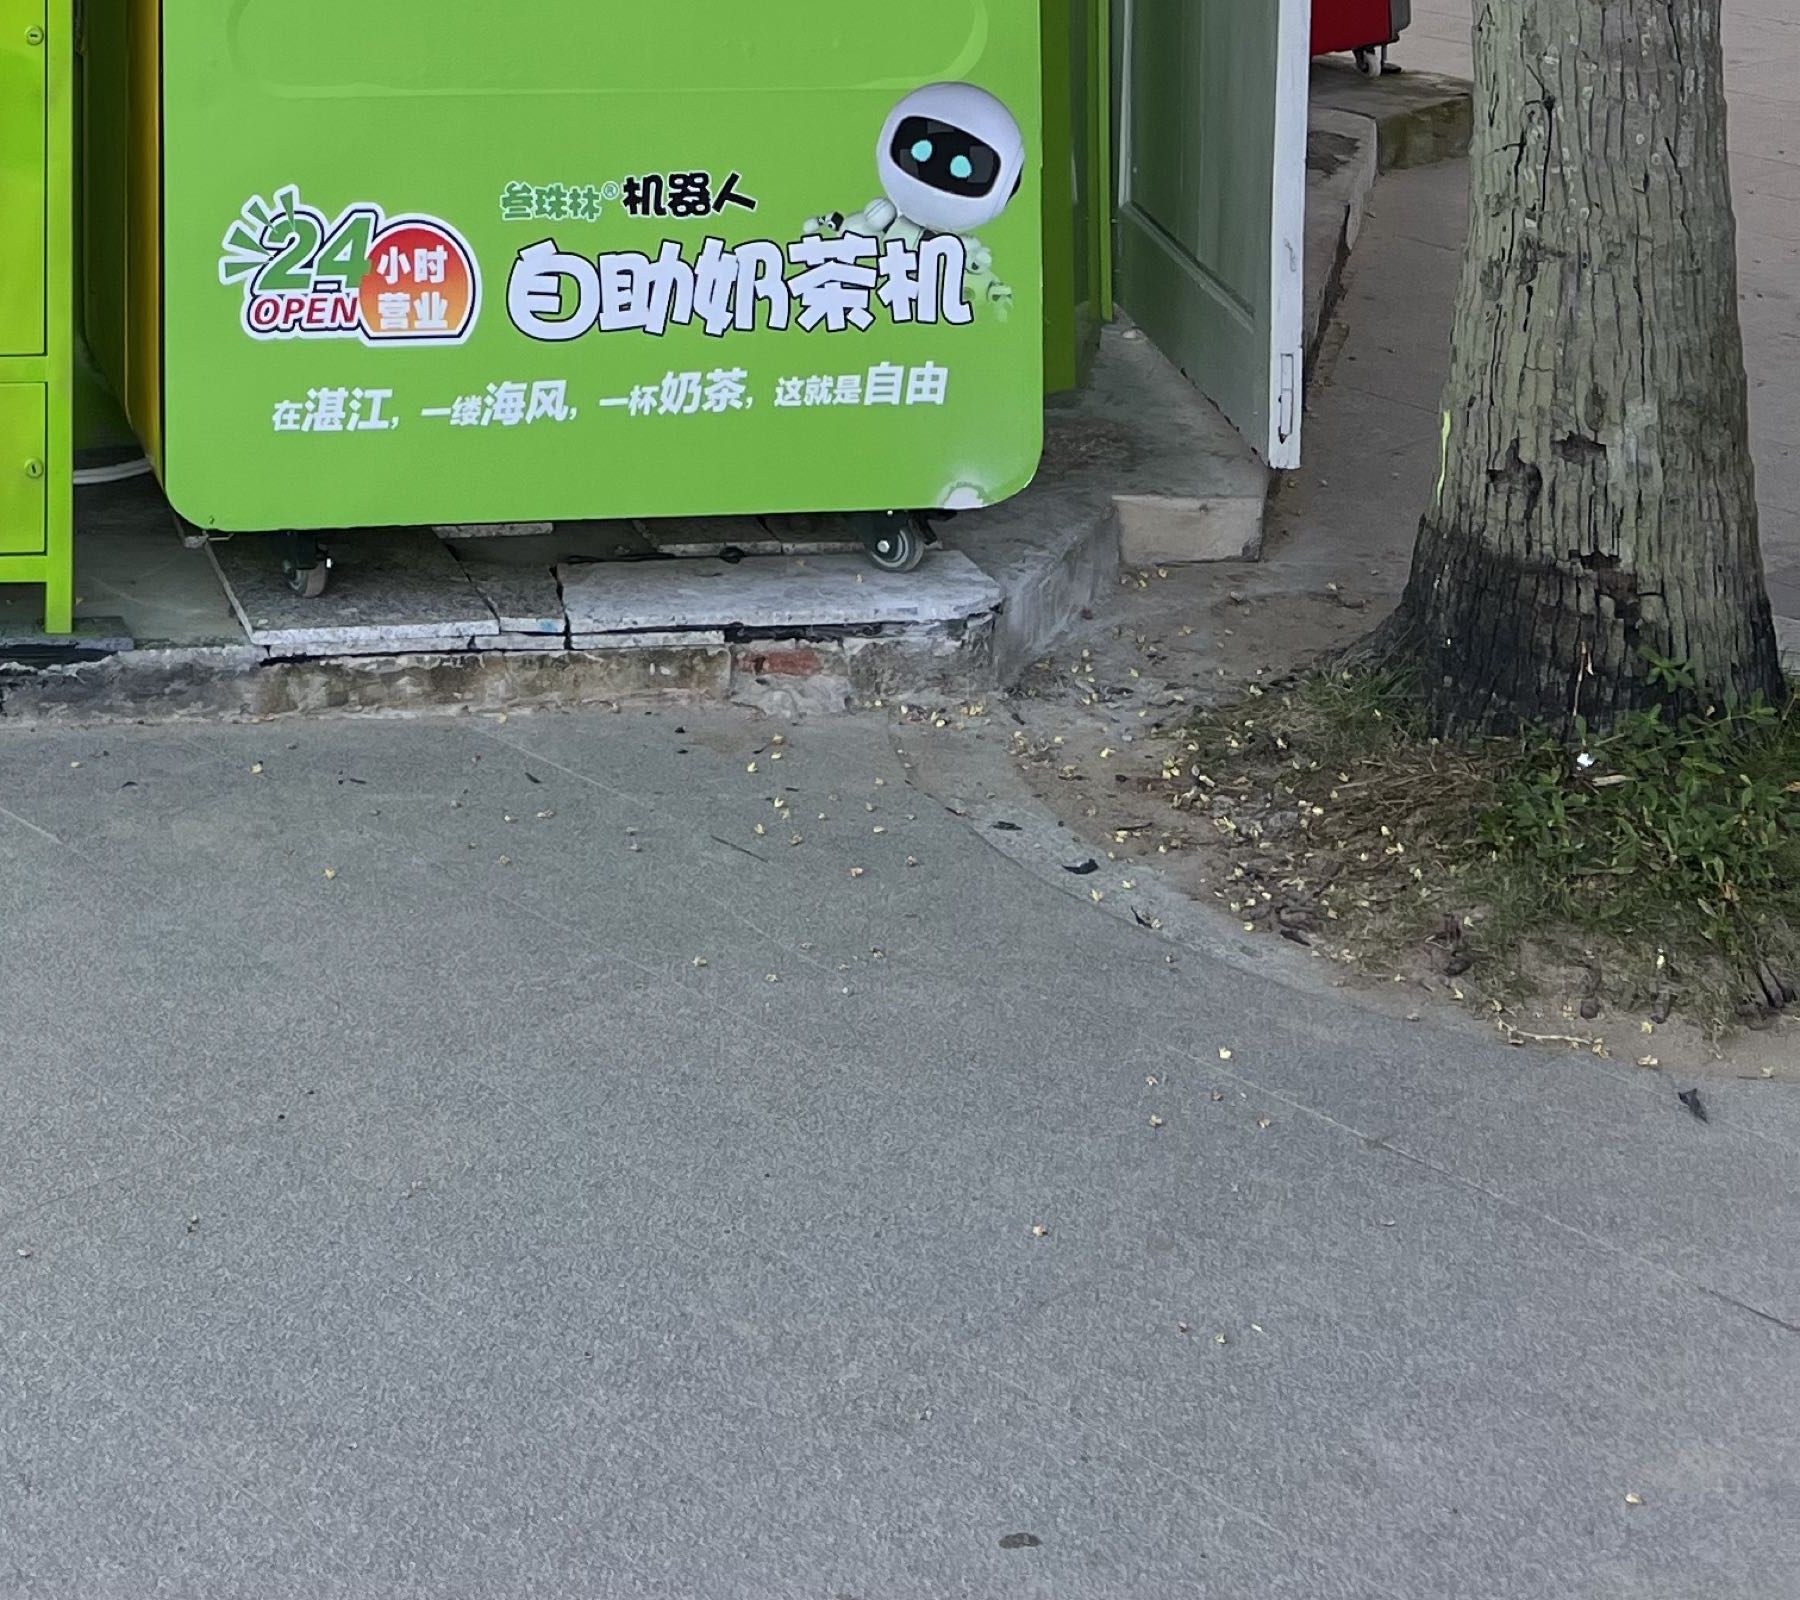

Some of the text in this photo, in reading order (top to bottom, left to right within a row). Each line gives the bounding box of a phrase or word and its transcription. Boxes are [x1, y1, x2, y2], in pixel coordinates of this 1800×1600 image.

[621, 171, 757, 219] 机器人
[258, 215, 372, 292] 24
[376, 244, 450, 285] 小时
[253, 295, 359, 326] OPEN
[506, 231, 974, 342] 自助奶茶机
[376, 292, 450, 331] 营业
[272, 361, 949, 433] 在湛江， 一缕海风， 一杯奶茶， 这就是自由
